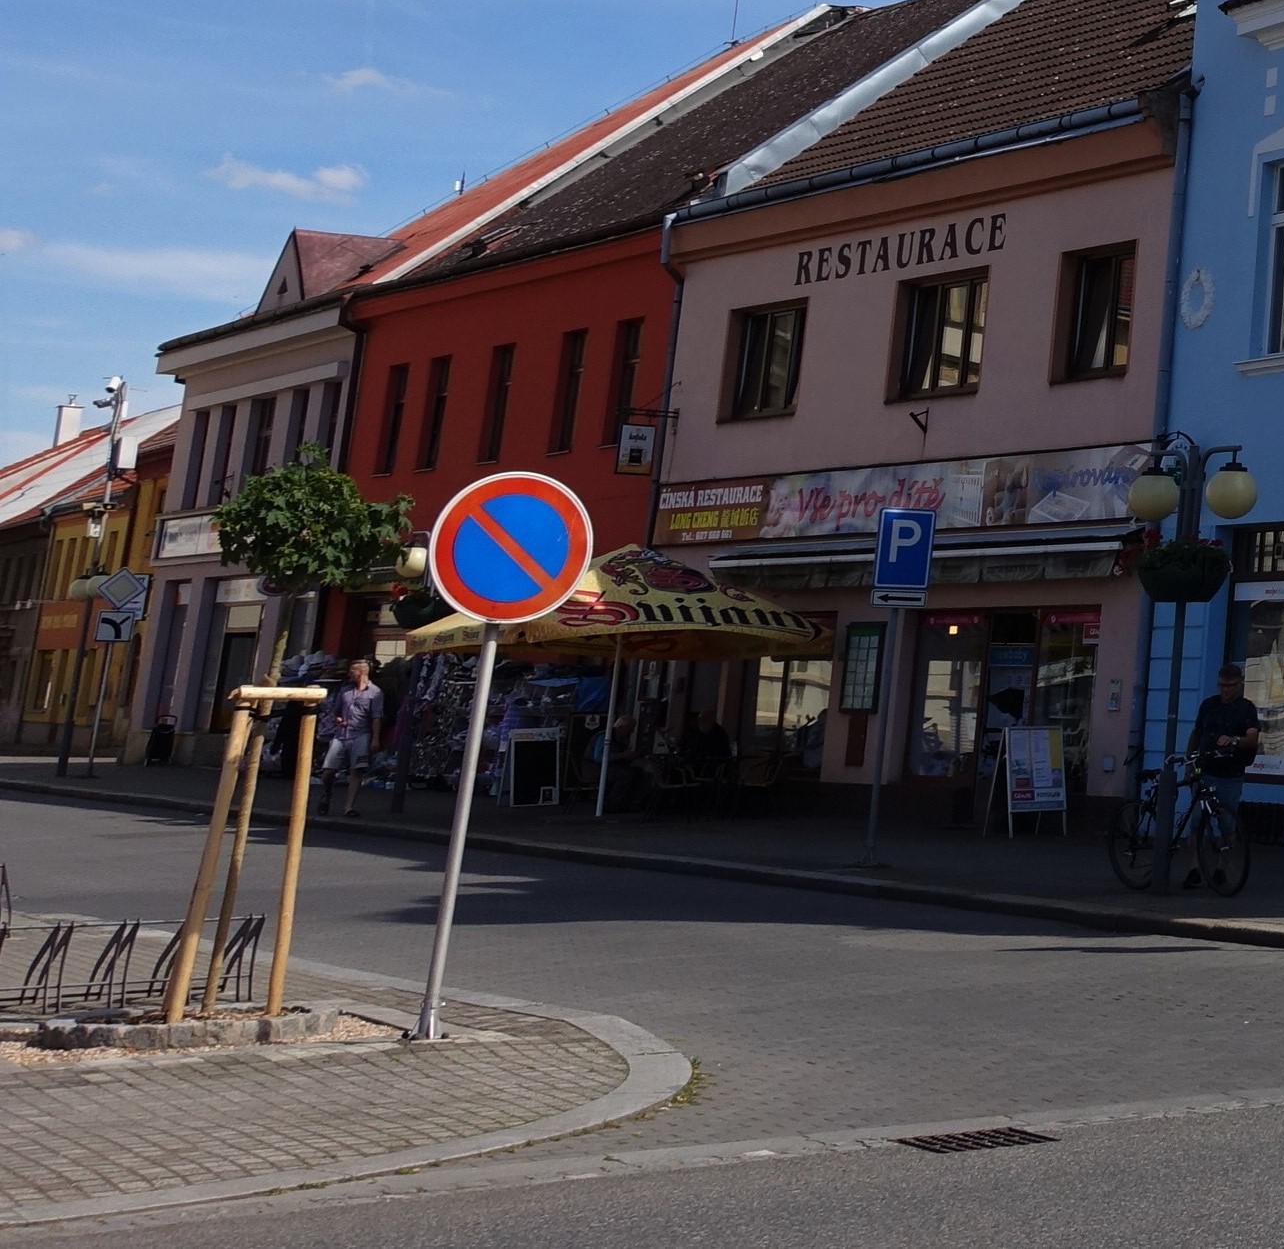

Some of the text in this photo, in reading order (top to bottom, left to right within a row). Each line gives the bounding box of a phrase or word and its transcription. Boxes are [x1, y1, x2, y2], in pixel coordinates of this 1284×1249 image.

[794, 213, 1007, 286] RESTAURACE
[660, 484, 764, 510] ČÍNSKÁ RESTAURACE
[834, 489, 886, 532] pro
[889, 519, 922, 563] P
